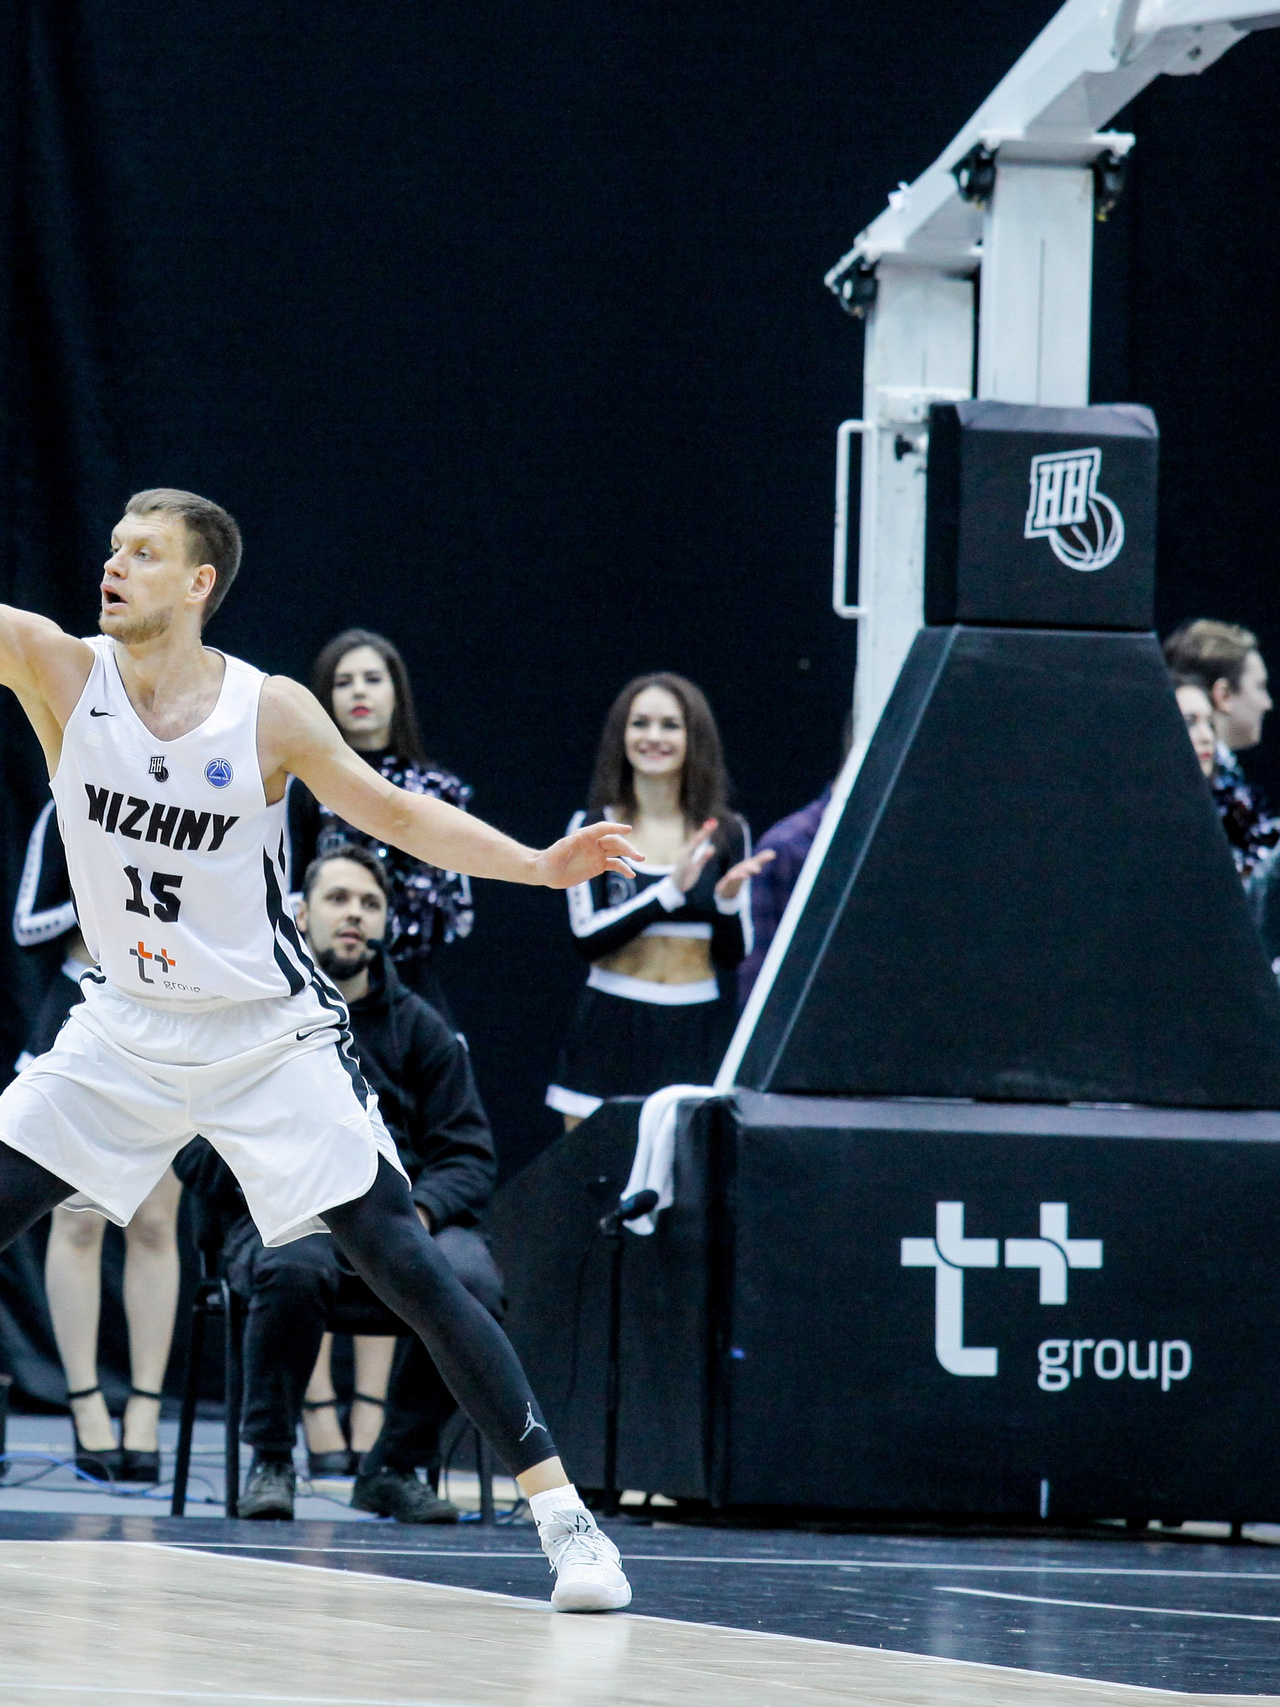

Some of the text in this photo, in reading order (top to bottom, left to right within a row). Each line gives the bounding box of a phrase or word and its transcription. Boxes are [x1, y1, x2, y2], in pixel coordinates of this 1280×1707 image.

[84, 783, 240, 852] NIZHNY
[123, 864, 184, 923] 15
[1037, 1338, 1193, 1392] group
